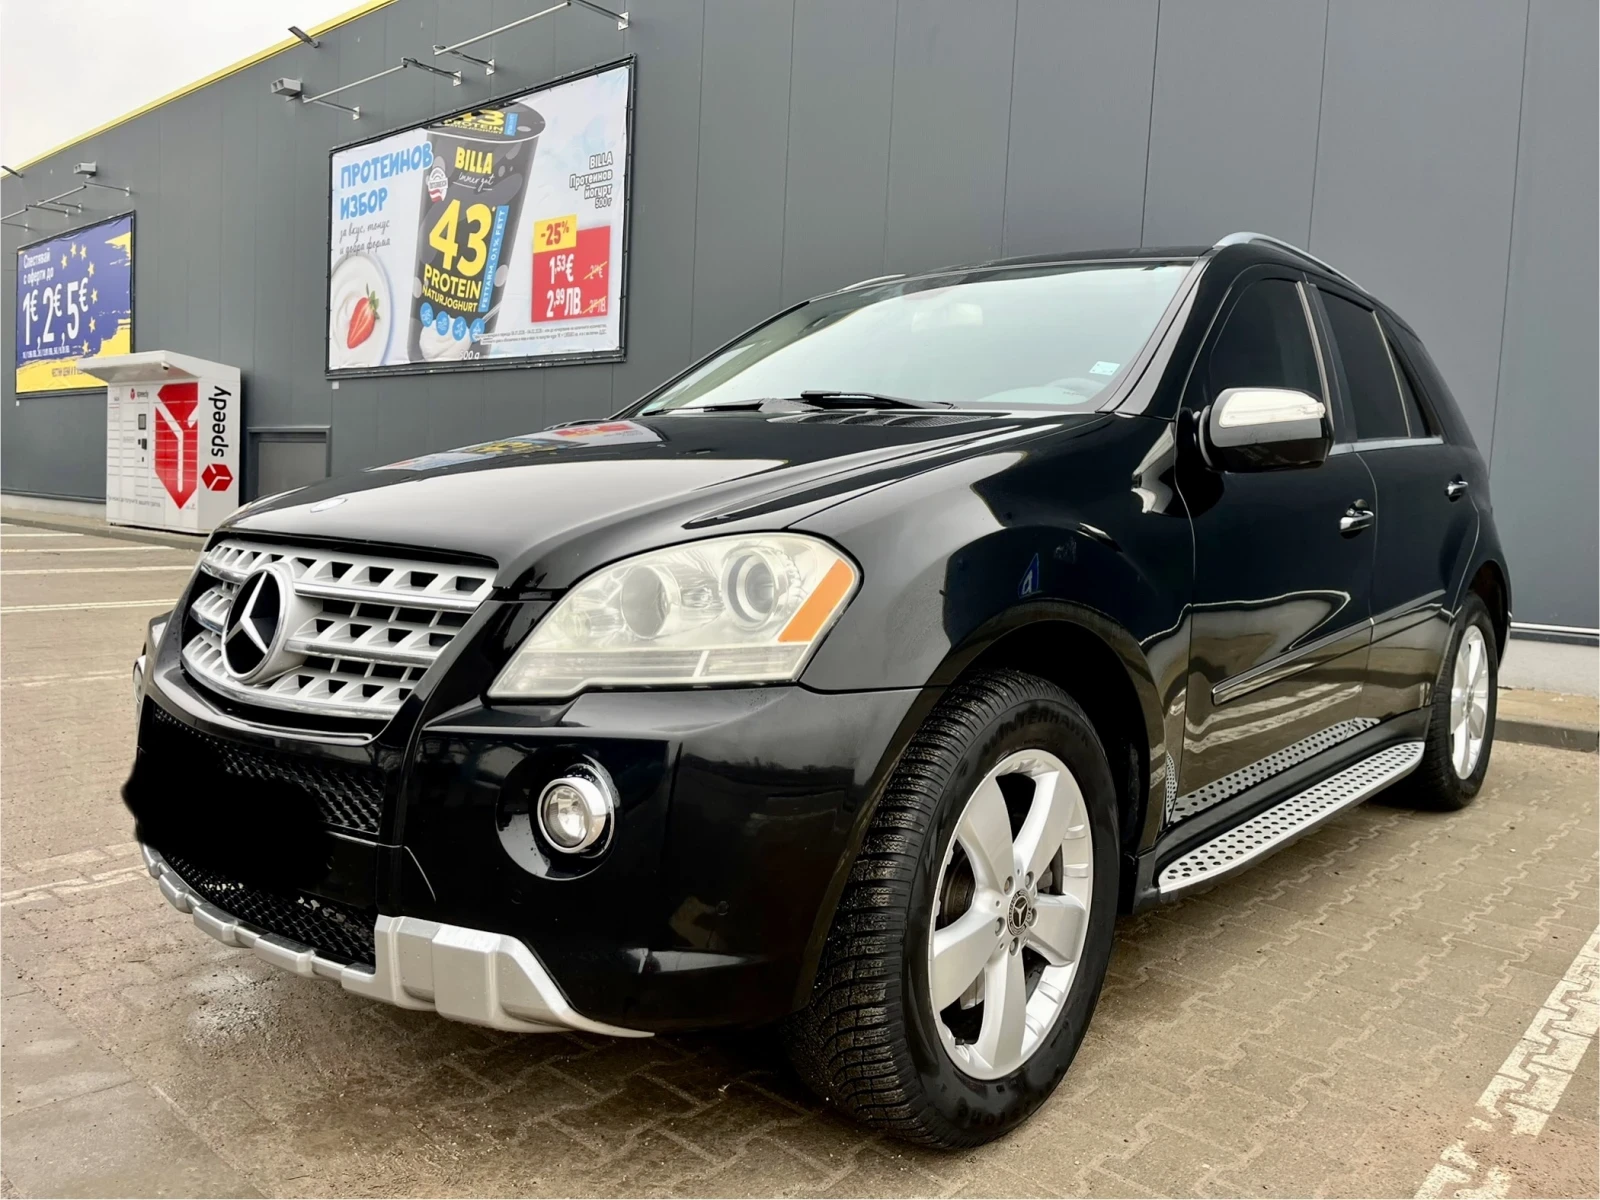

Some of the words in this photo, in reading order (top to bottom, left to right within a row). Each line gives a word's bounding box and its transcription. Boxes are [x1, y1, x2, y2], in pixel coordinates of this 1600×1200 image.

[340, 142, 433, 189] ПРОТЕИНОВ
[455, 146, 493, 174] BILLA
[589, 151, 613, 169] BILLA
[459, 172, 478, 184] immer
[478, 173, 495, 192] gut
[569, 169, 613, 190] Протеинов
[584, 183, 612, 200] йогурт
[340, 187, 387, 220] ИЗБОР
[367, 220, 390, 235] тонус
[495, 210, 505, 235] FETT
[541, 220, 570, 246] -25%
[366, 236, 391, 254] форма
[23, 248, 51, 268] Спестявай
[549, 253, 575, 284] 1,53€
[23, 274, 27, 285] с
[28, 268, 46, 287] оферти
[46, 267, 54, 281] до
[424, 264, 482, 299] PROTEIN
[422, 285, 478, 312] NATURJOGHURT
[208, 385, 231, 457] speedy
